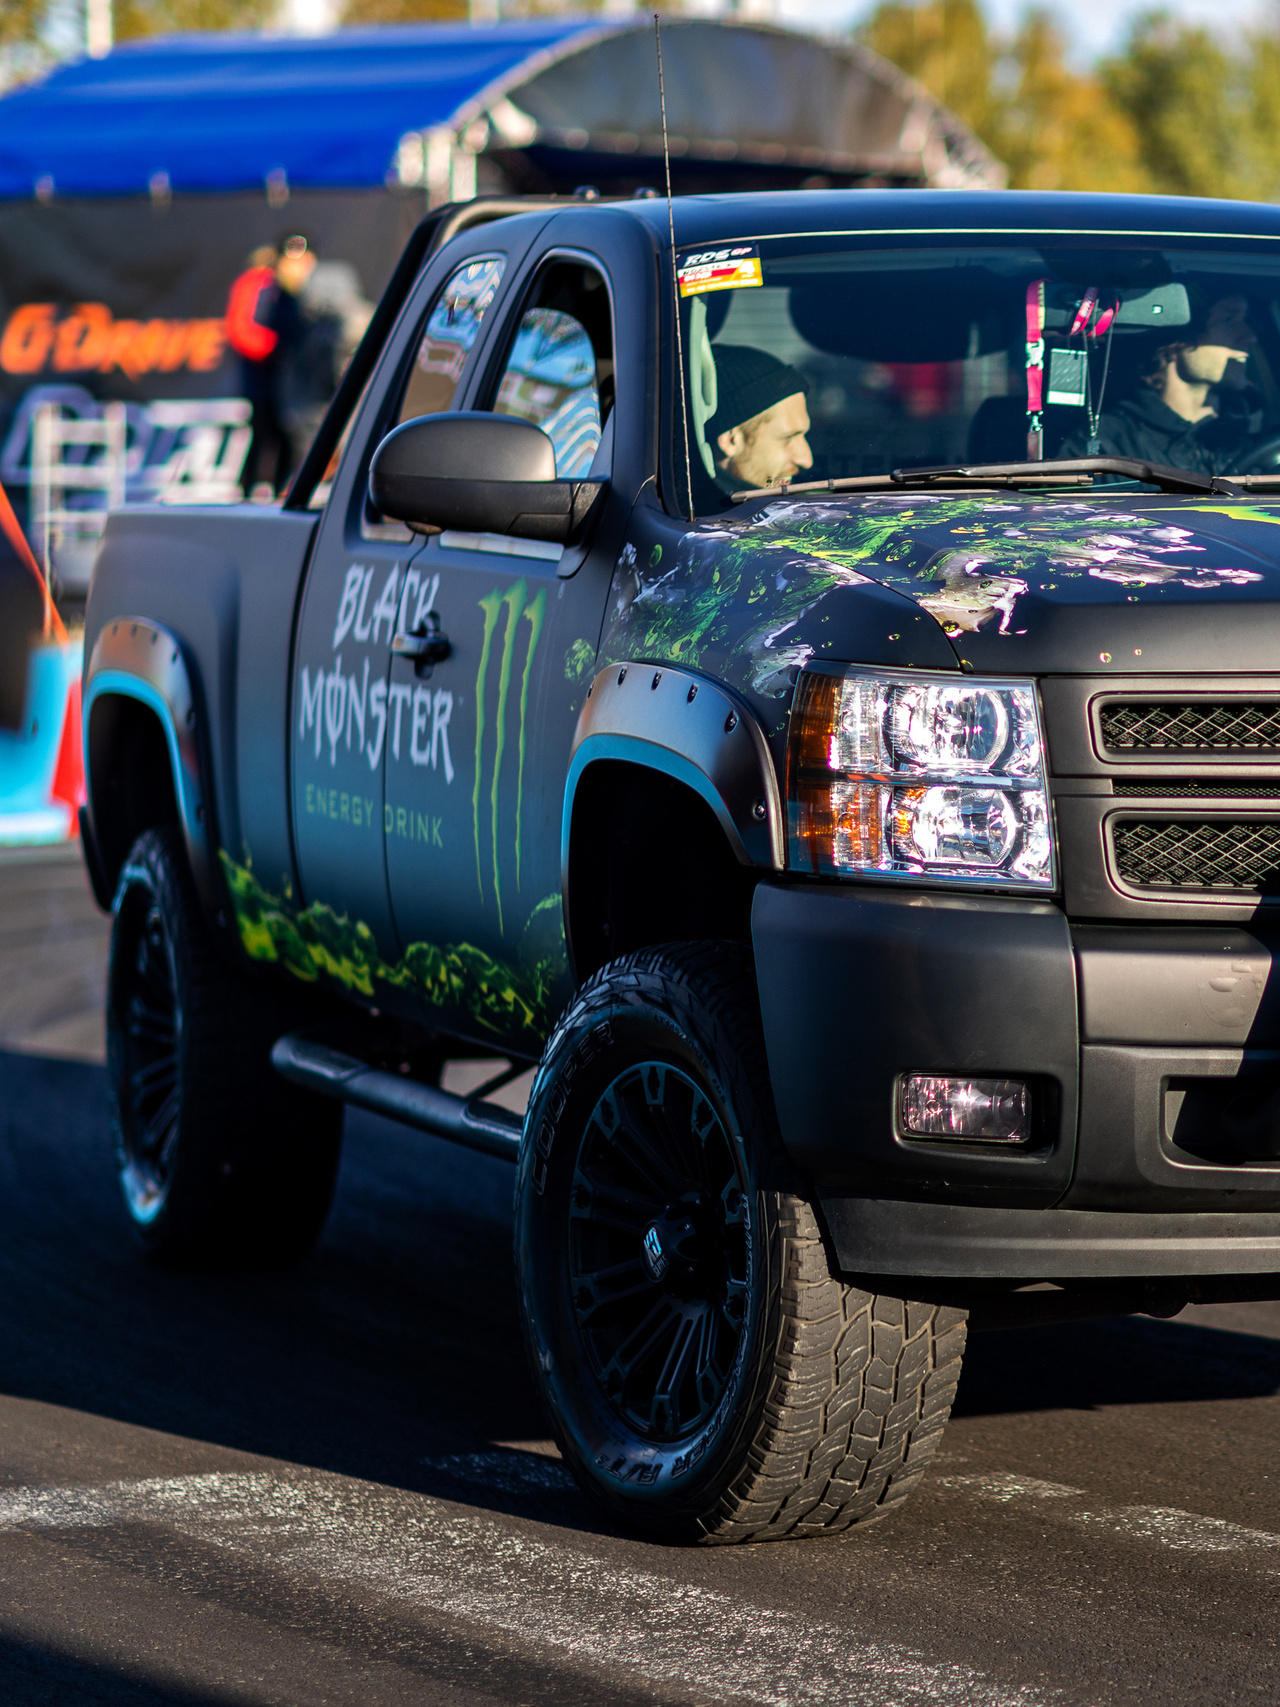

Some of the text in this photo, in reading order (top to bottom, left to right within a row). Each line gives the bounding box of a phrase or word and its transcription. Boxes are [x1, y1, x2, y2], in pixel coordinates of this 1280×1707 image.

[683, 249, 732, 268] RDS
[331, 560, 440, 651] BLACK
[305, 784, 443, 848] ENERGY DRINK
[531, 1020, 615, 1196] COOPER
